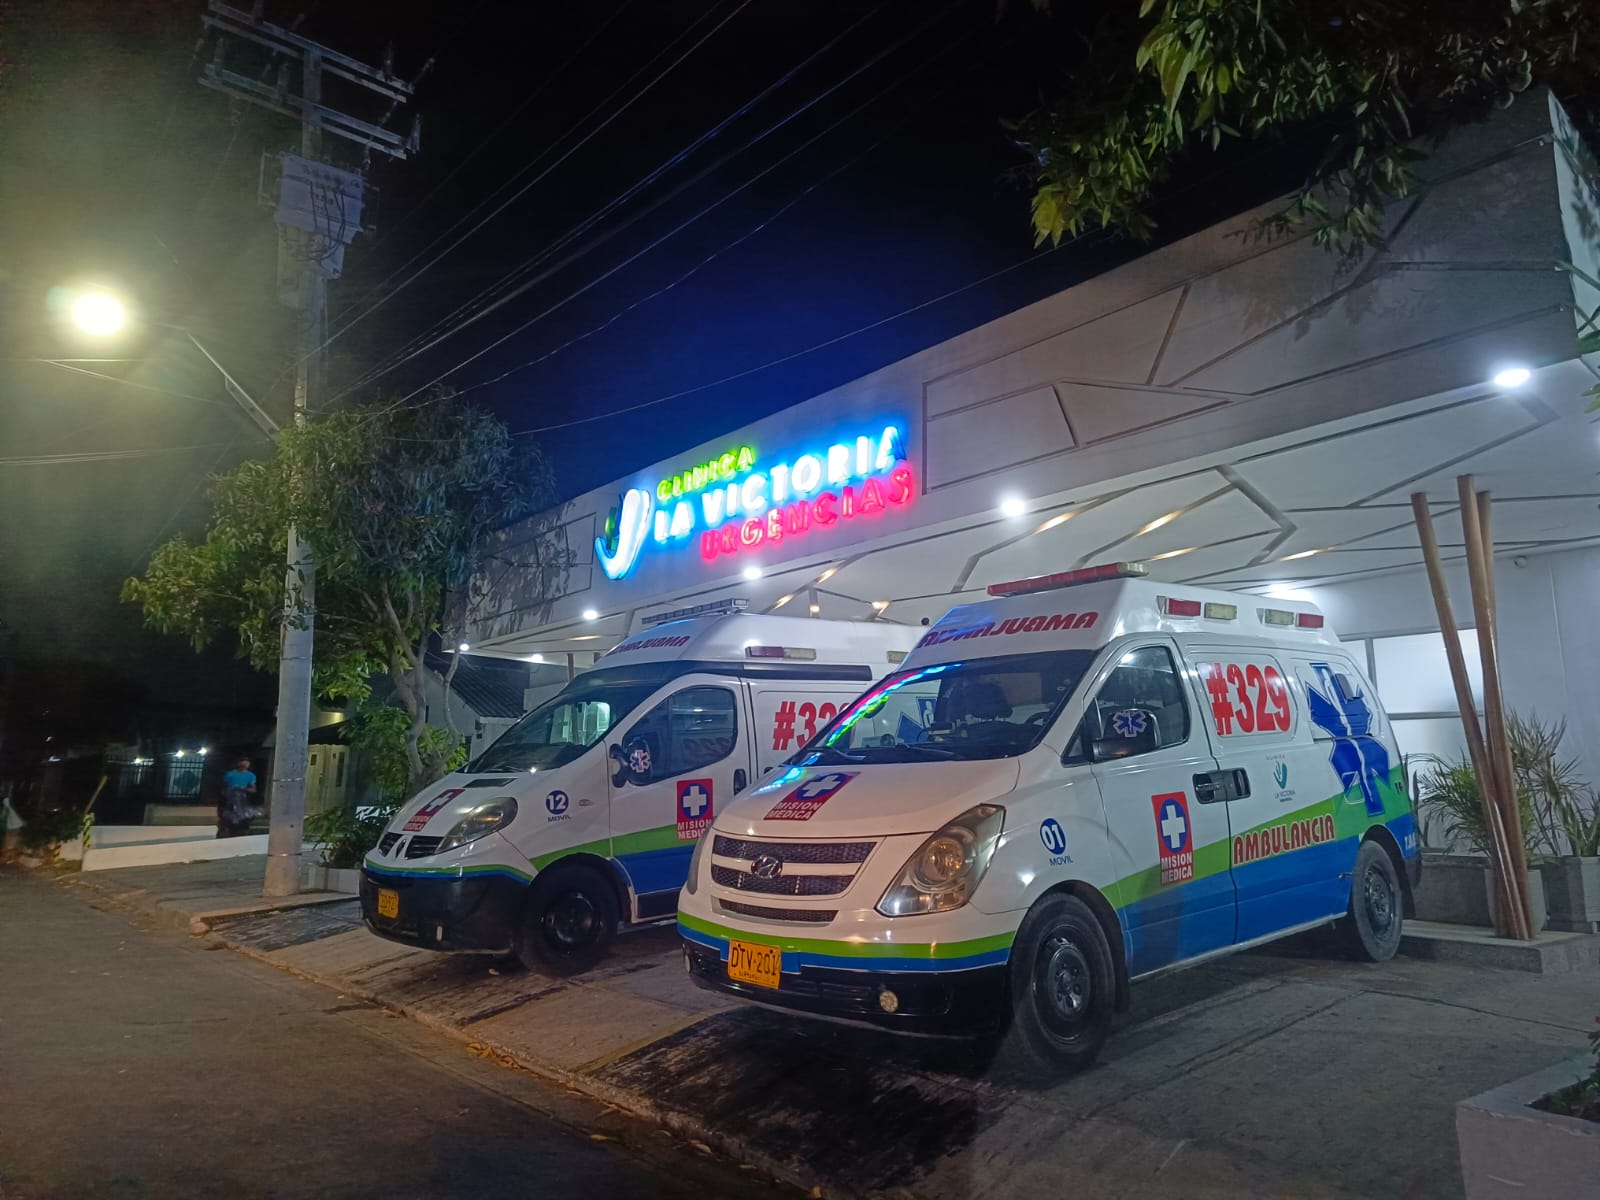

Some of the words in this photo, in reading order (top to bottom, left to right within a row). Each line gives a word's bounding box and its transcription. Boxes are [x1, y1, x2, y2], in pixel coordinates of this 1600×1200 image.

[653, 502, 694, 541] LA
[702, 426, 907, 526] VICTORIA
[657, 446, 753, 501] CLINICA
[701, 468, 914, 561] URGENCIAS
[1206, 663, 1290, 736] #329
[772, 700, 851, 751] #3
[547, 794, 567, 811] 12
[775, 802, 822, 810] MISION
[768, 811, 813, 819] MEDICA
[678, 829, 706, 840] MEDIC
[1041, 823, 1065, 850] 01
[1233, 814, 1335, 865] AMBULANCIA
[1049, 855, 1075, 867] MOVIL
[1161, 851, 1193, 870] MISION
[1161, 865, 1193, 885] MEDICA
